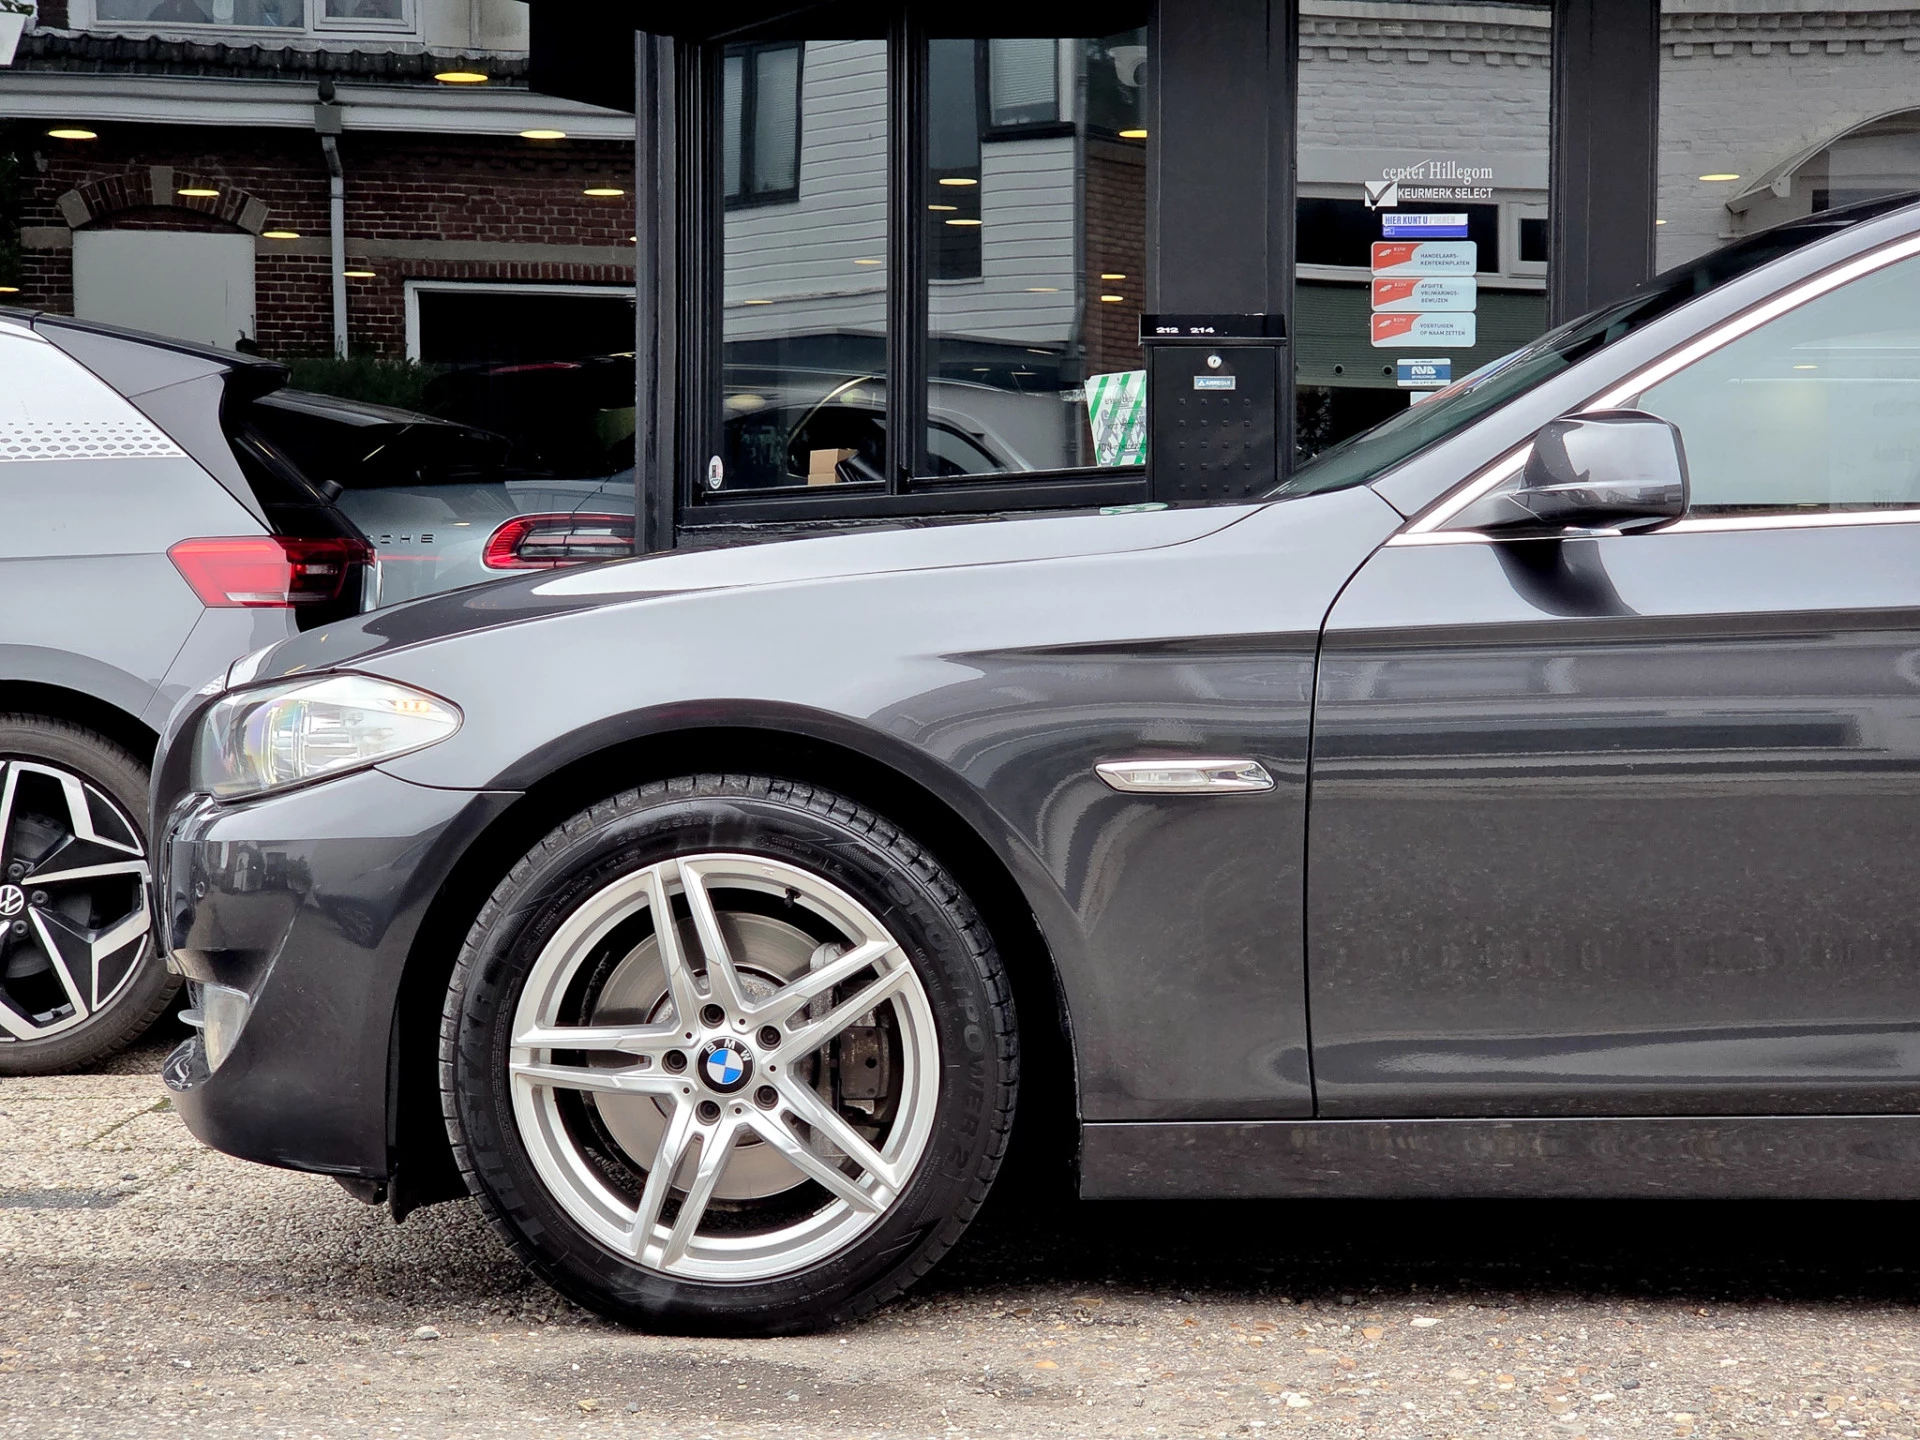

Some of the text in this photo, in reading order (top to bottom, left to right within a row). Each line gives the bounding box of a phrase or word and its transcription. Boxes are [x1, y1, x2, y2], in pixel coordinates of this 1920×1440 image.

[1382, 160, 1493, 185] center Hillegom
[1398, 188, 1493, 199] KEURMERK SELECT
[1385, 216, 1402, 225] HIER
[1403, 216, 1422, 225] KUNT
[1423, 216, 1428, 225] U
[705, 1038, 752, 1062] BMW
